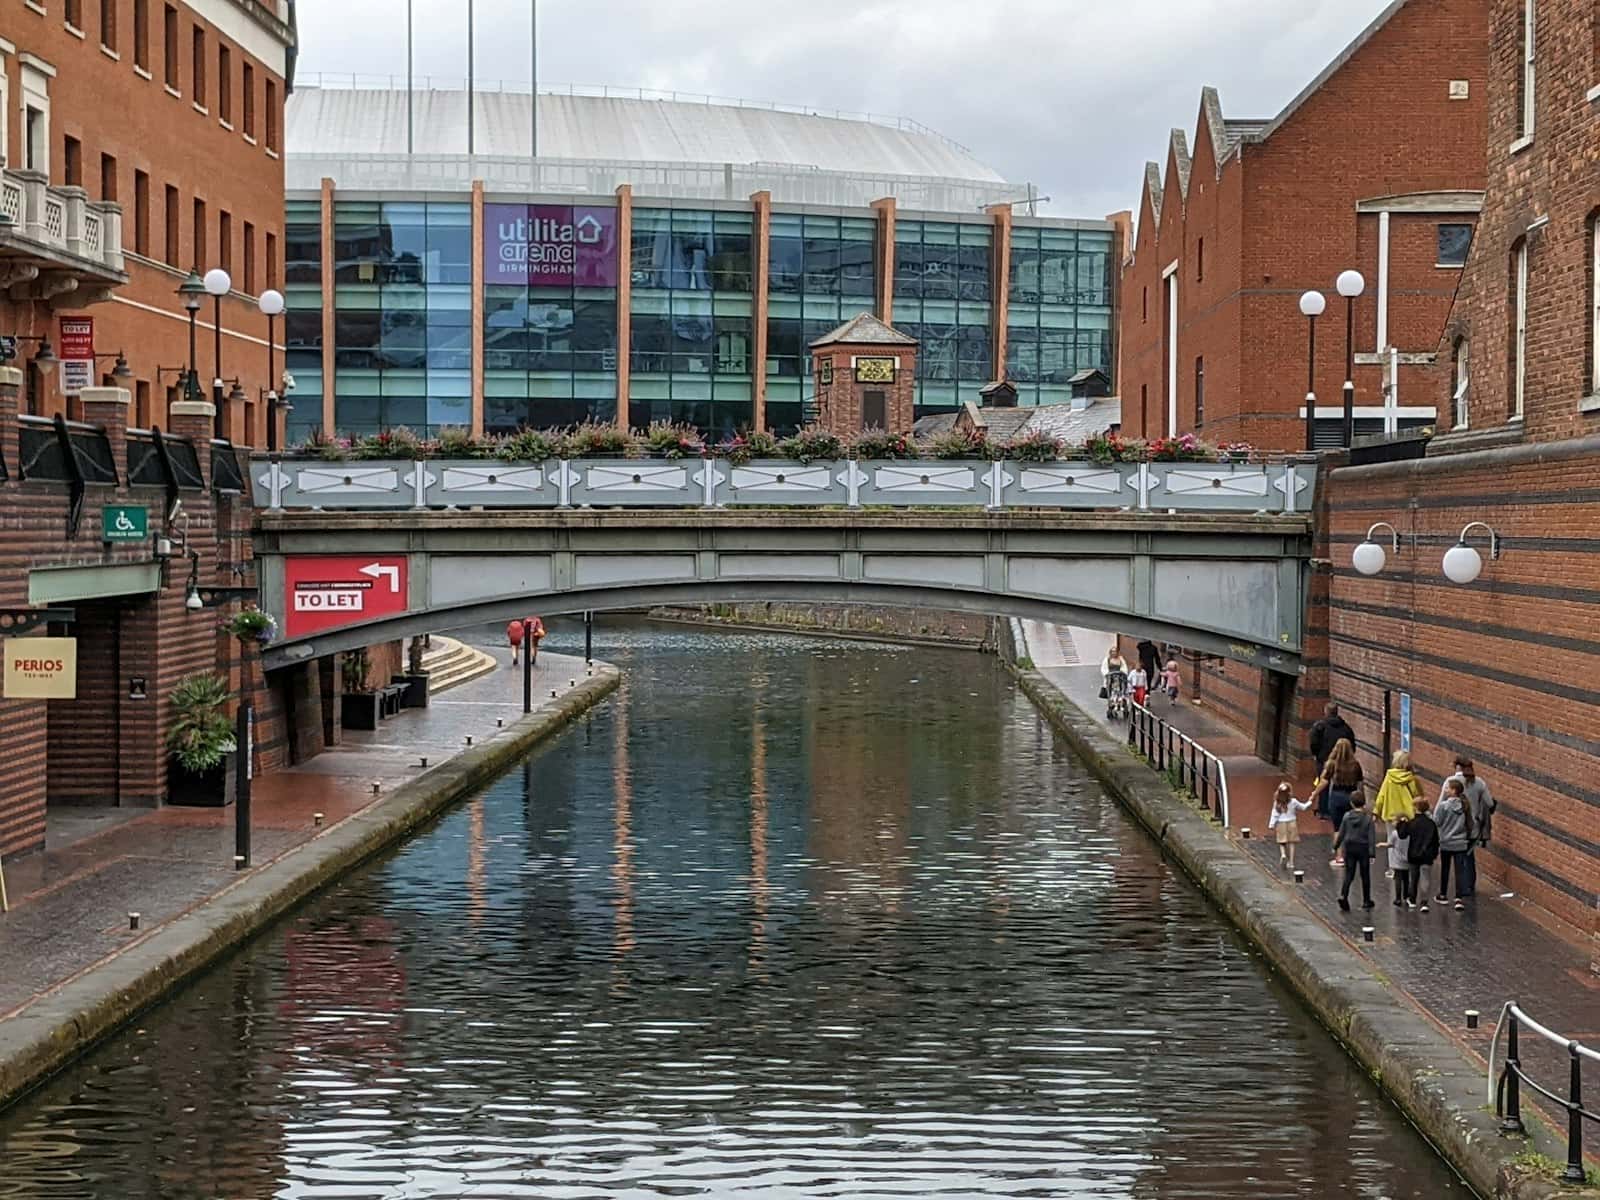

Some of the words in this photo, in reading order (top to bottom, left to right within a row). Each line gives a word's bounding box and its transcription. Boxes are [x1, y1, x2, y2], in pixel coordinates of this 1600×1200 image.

[499, 218, 576, 242] utilita
[499, 242, 576, 263] arena
[499, 263, 576, 274] BIRMINGHAM
[298, 594, 321, 607] TO
[327, 594, 359, 607] LET
[14, 659, 63, 671] PERIOS
